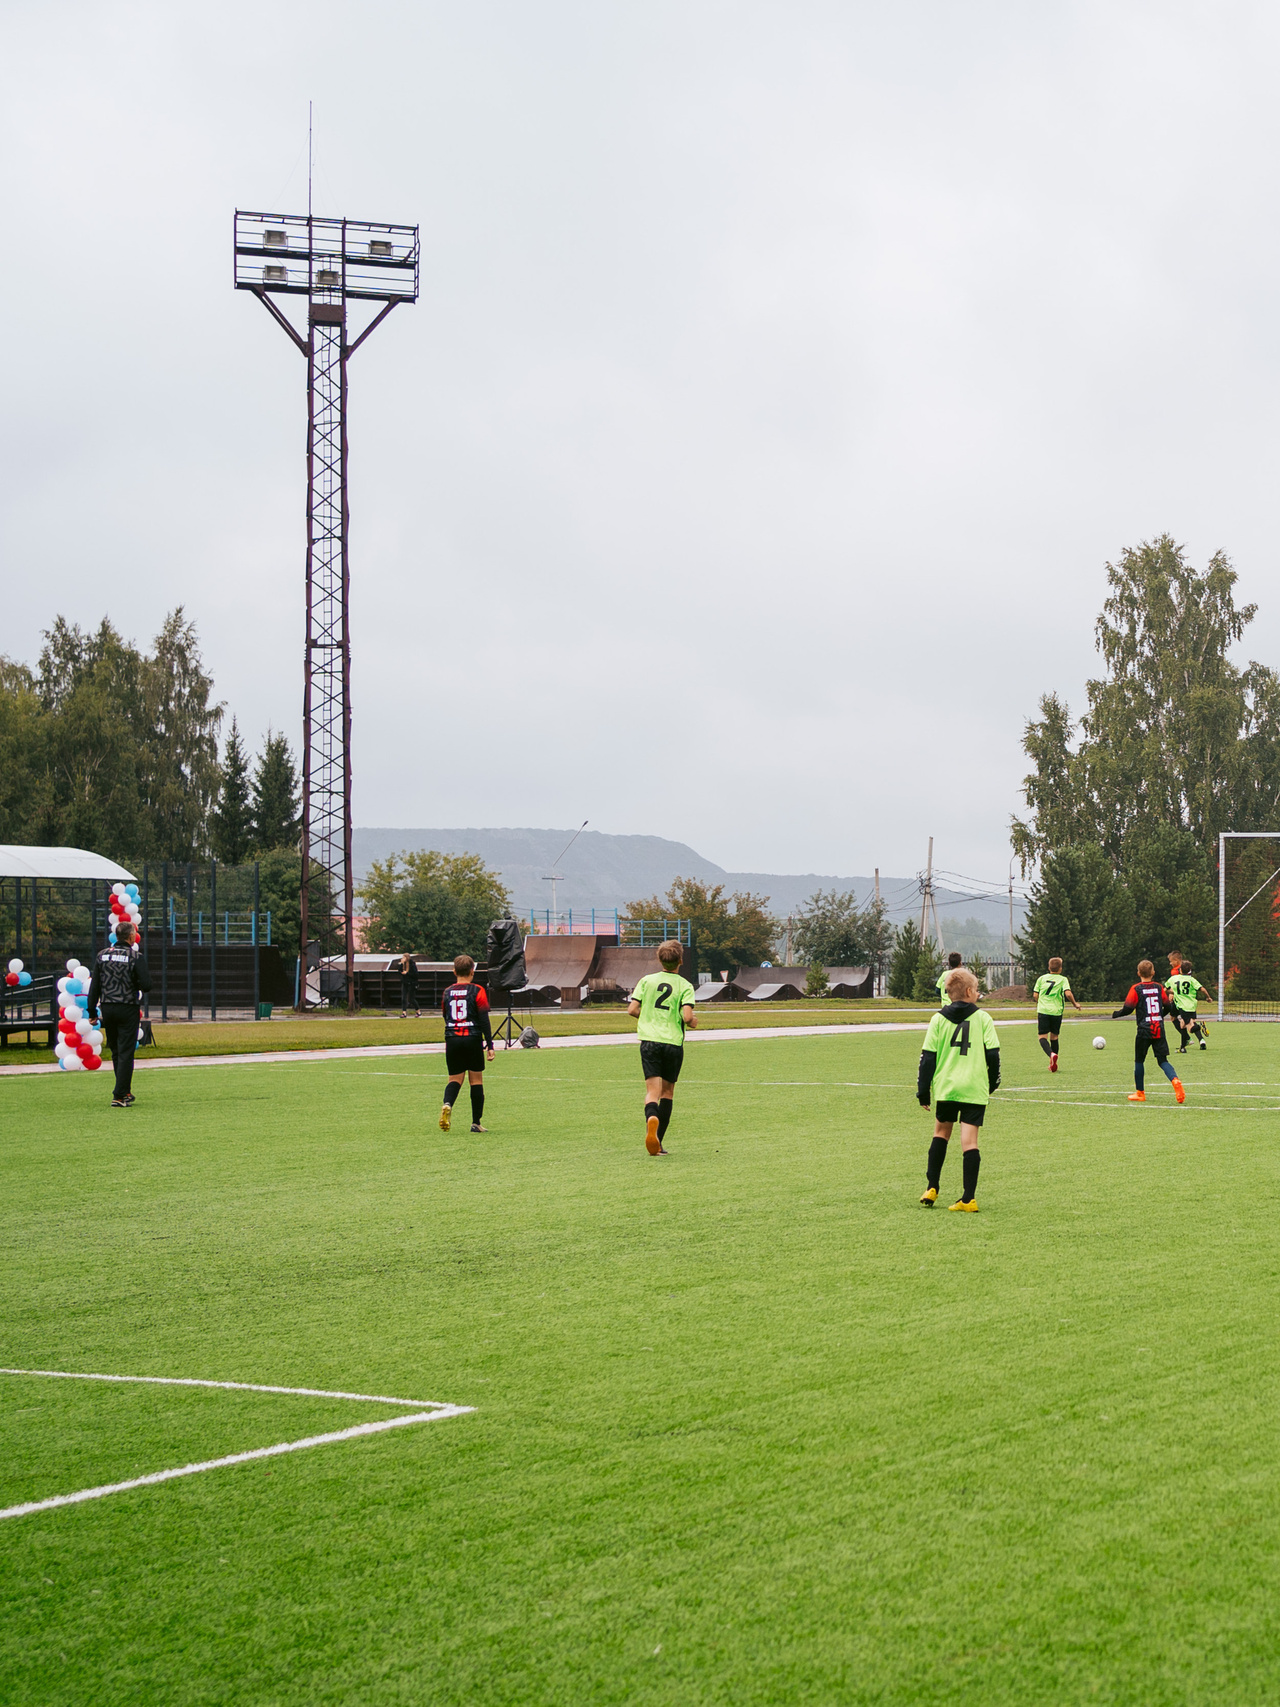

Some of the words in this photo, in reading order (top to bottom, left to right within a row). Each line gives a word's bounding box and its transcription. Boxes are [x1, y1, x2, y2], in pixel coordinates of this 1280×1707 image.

[654, 982, 673, 1011] 2
[1045, 980, 1056, 996] 7
[1174, 980, 1191, 995] 13
[449, 999, 468, 1021] 13
[1145, 996, 1160, 1014] 15
[950, 1020, 971, 1056] 4
